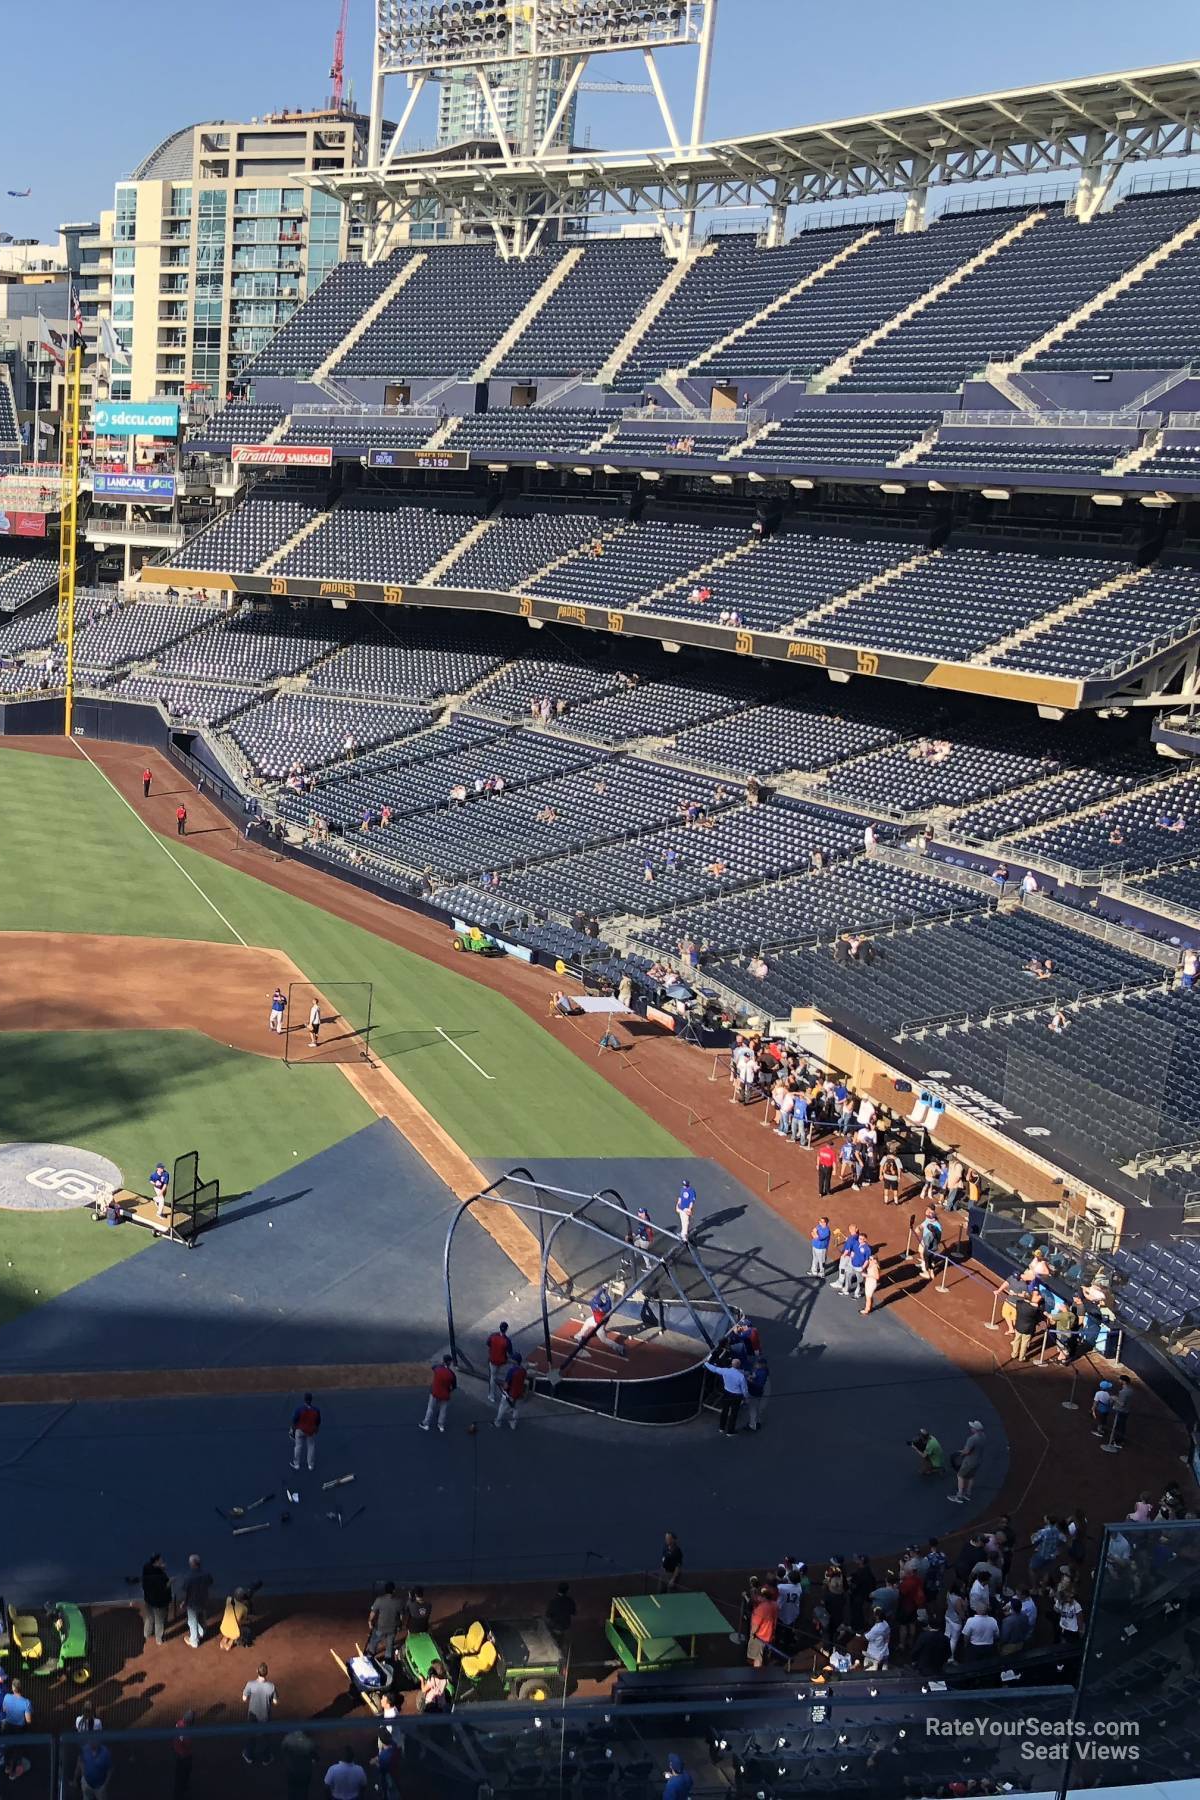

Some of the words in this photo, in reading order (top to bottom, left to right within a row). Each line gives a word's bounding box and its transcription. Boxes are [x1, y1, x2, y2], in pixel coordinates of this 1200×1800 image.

[111, 412, 173, 426] sdccu.com
[233, 447, 286, 462] Tarantino
[287, 453, 329, 464] SAUSAGES
[418, 458, 449, 467] $2,150
[107, 477, 146, 489] LANDCARE
[320, 583, 356, 599] PADRES
[556, 606, 586, 625] PADRES
[786, 642, 826, 665] PADRES
[952, 1085, 1022, 1120] PADRES
